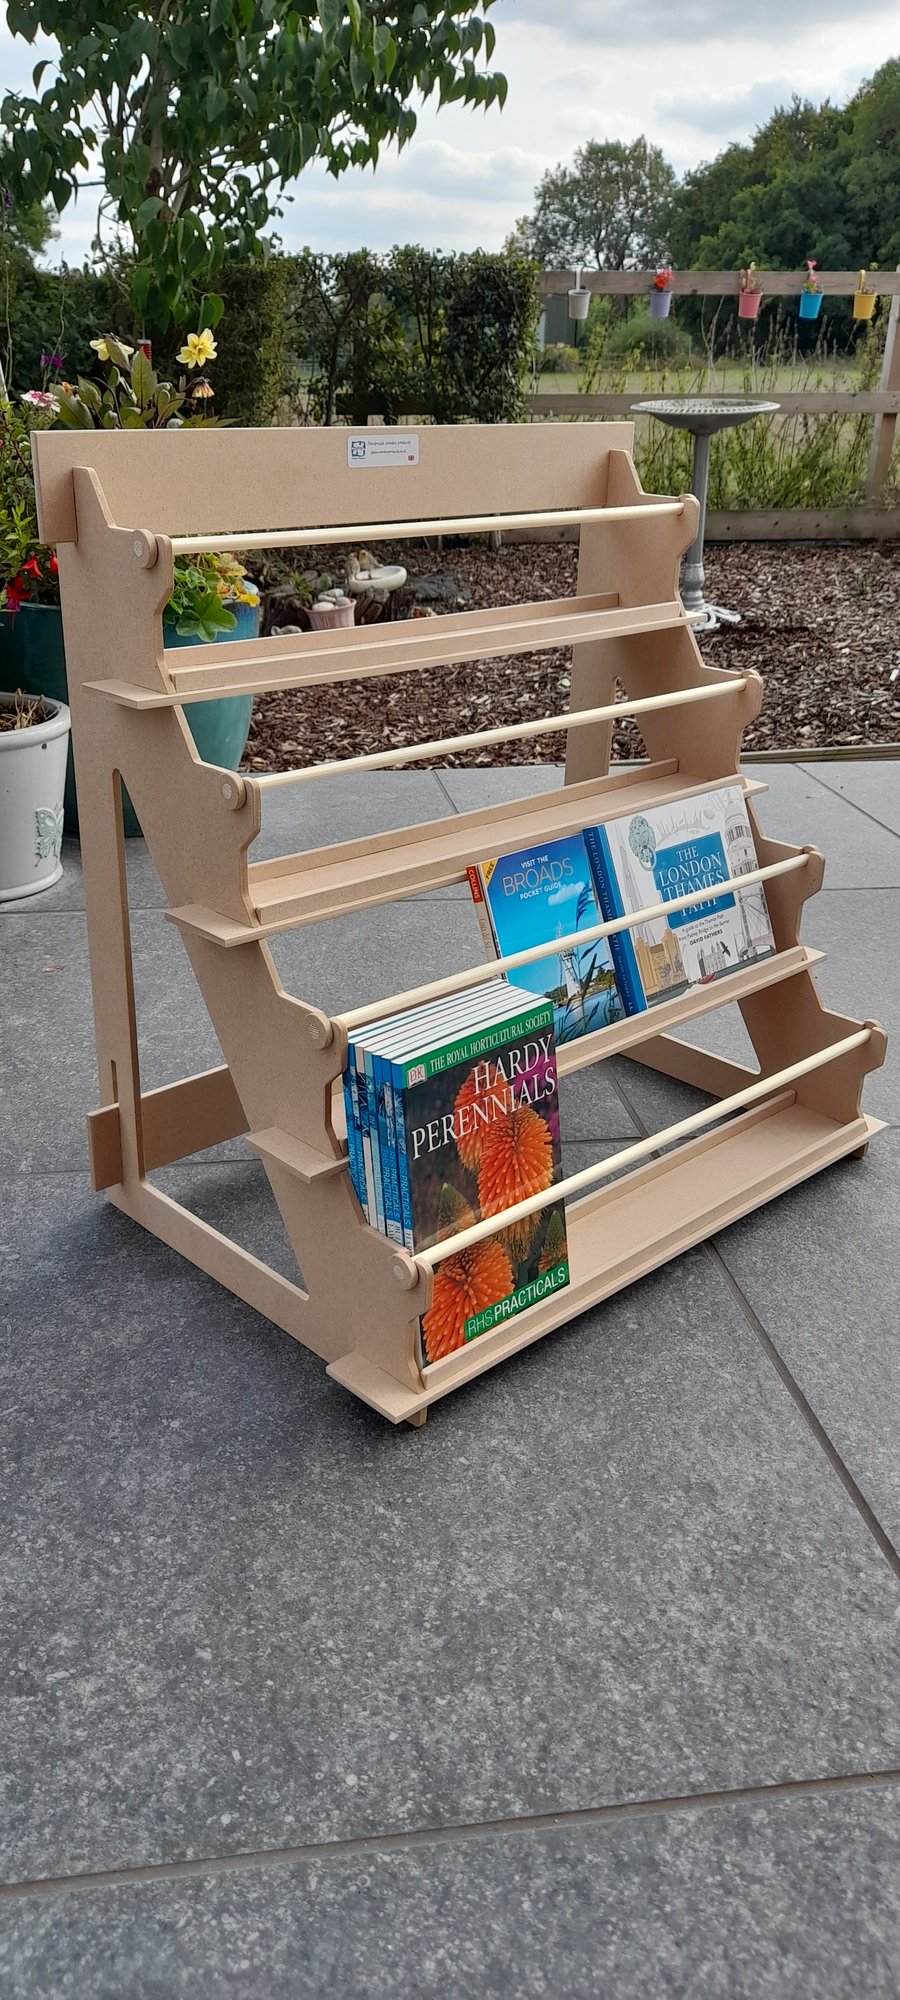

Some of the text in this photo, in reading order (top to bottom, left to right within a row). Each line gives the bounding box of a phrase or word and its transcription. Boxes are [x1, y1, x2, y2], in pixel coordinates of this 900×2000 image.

[520, 855, 550, 869] VISIT THE
[658, 852, 722, 887] LONDON
[676, 846, 699, 862] THE
[468, 869, 481, 900] COLLINS
[485, 861, 495, 880] FREE
[502, 857, 574, 897] BROADS
[592, 851, 606, 889] LONDON
[602, 891, 613, 920] THAM
[520, 881, 563, 900] POCKET GUIDE
[690, 929, 723, 946] DAVID FATHERS
[430, 1010, 552, 1073] THE ROYAL HORTICULTURAL SOCIETY
[410, 1067, 424, 1081] DK
[473, 1034, 553, 1095] HARDY
[411, 1066, 556, 1161] PERENNIALS
